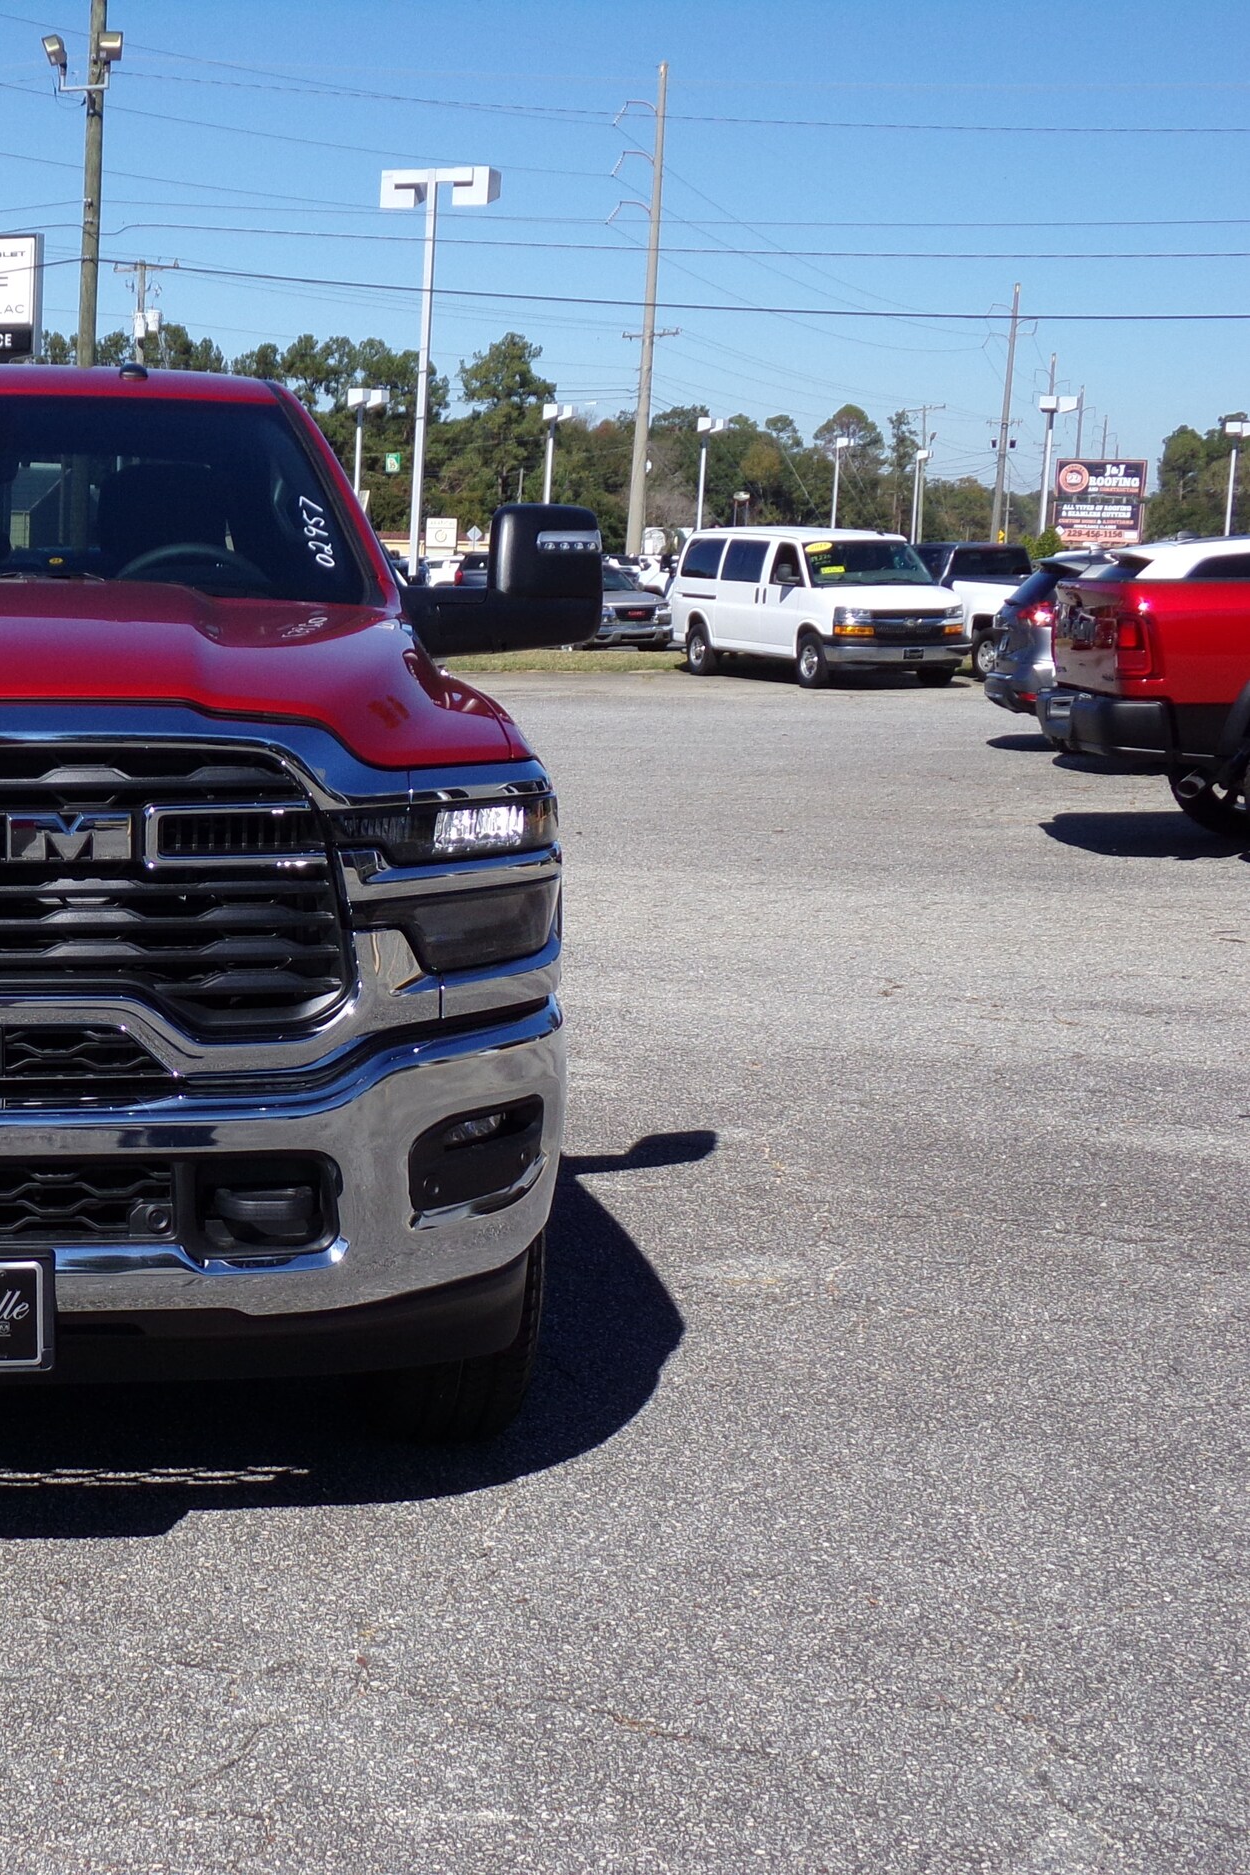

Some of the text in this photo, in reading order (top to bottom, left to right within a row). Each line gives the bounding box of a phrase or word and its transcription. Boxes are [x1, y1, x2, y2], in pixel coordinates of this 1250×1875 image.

[1104, 464, 1126, 477] J&J
[1088, 476, 1140, 487] ROOFING
[299, 495, 335, 568] 02957
